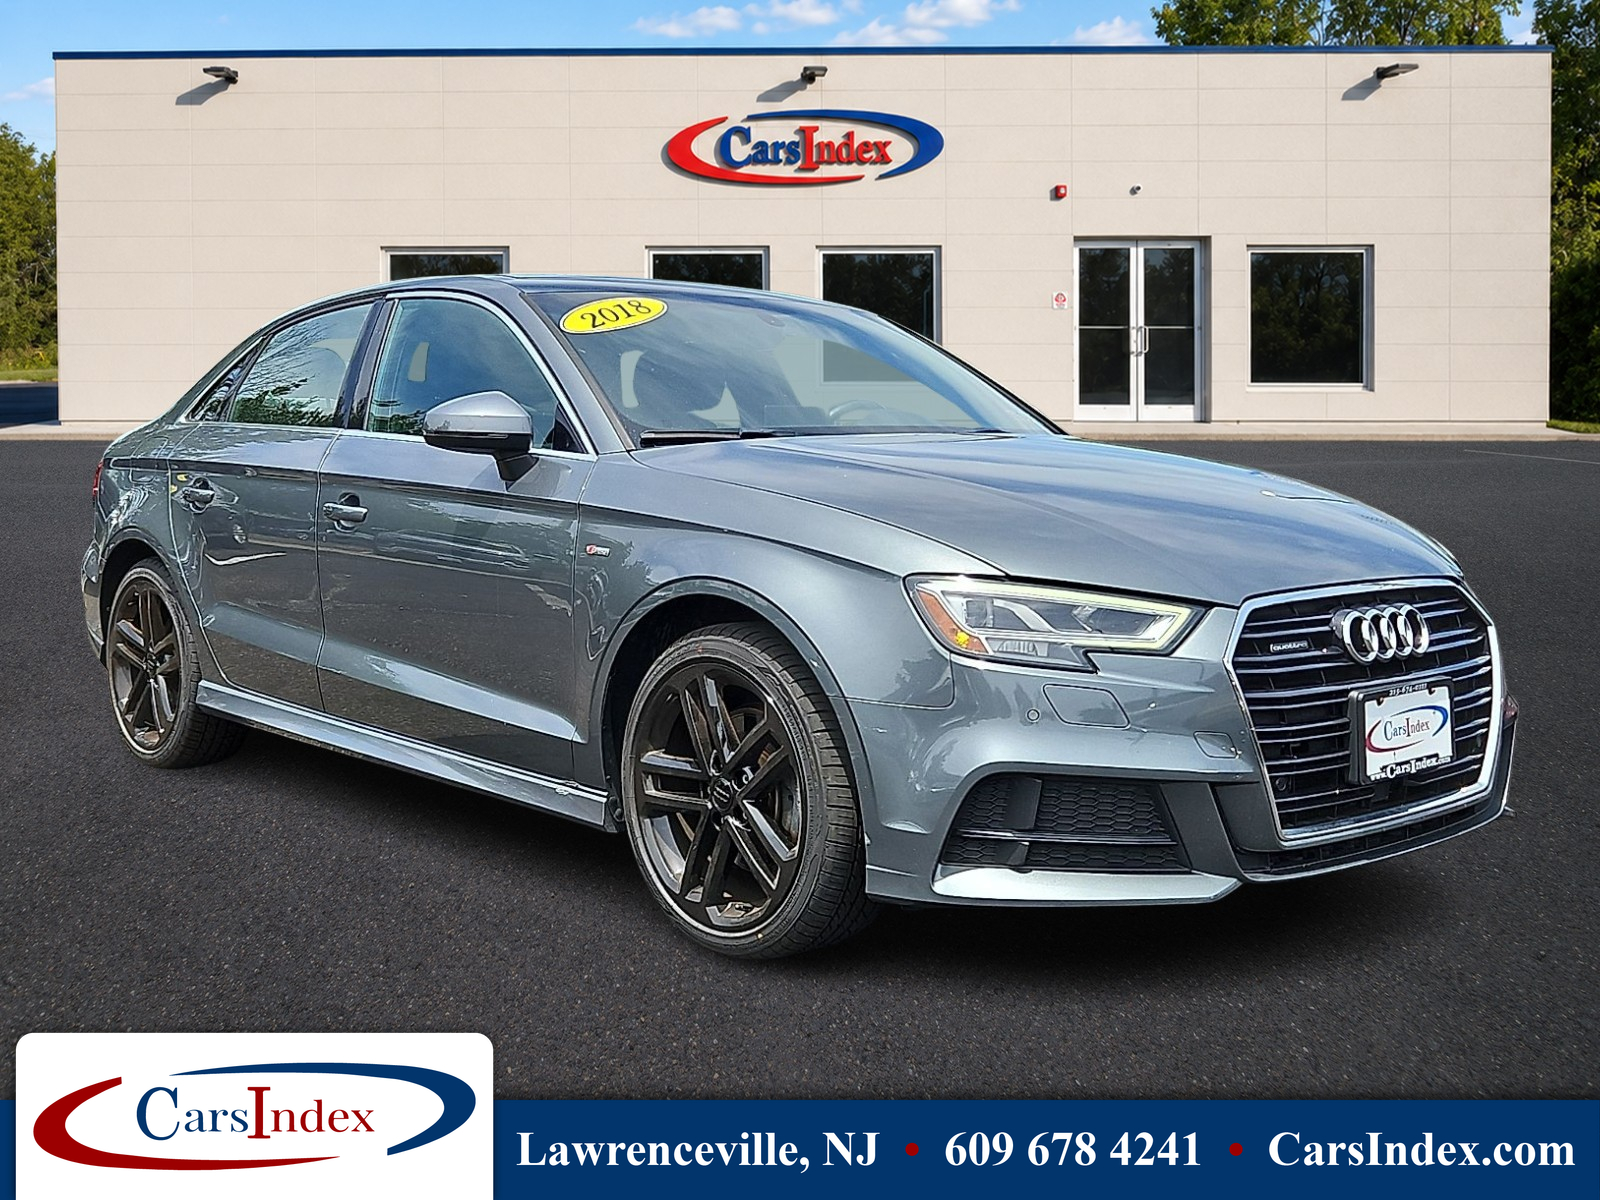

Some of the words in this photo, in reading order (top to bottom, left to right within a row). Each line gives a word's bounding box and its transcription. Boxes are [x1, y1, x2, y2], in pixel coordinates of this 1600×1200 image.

[719, 125, 893, 171] CarsIndex
[580, 299, 652, 328] 2018
[1384, 717, 1431, 741] CarsIndex
